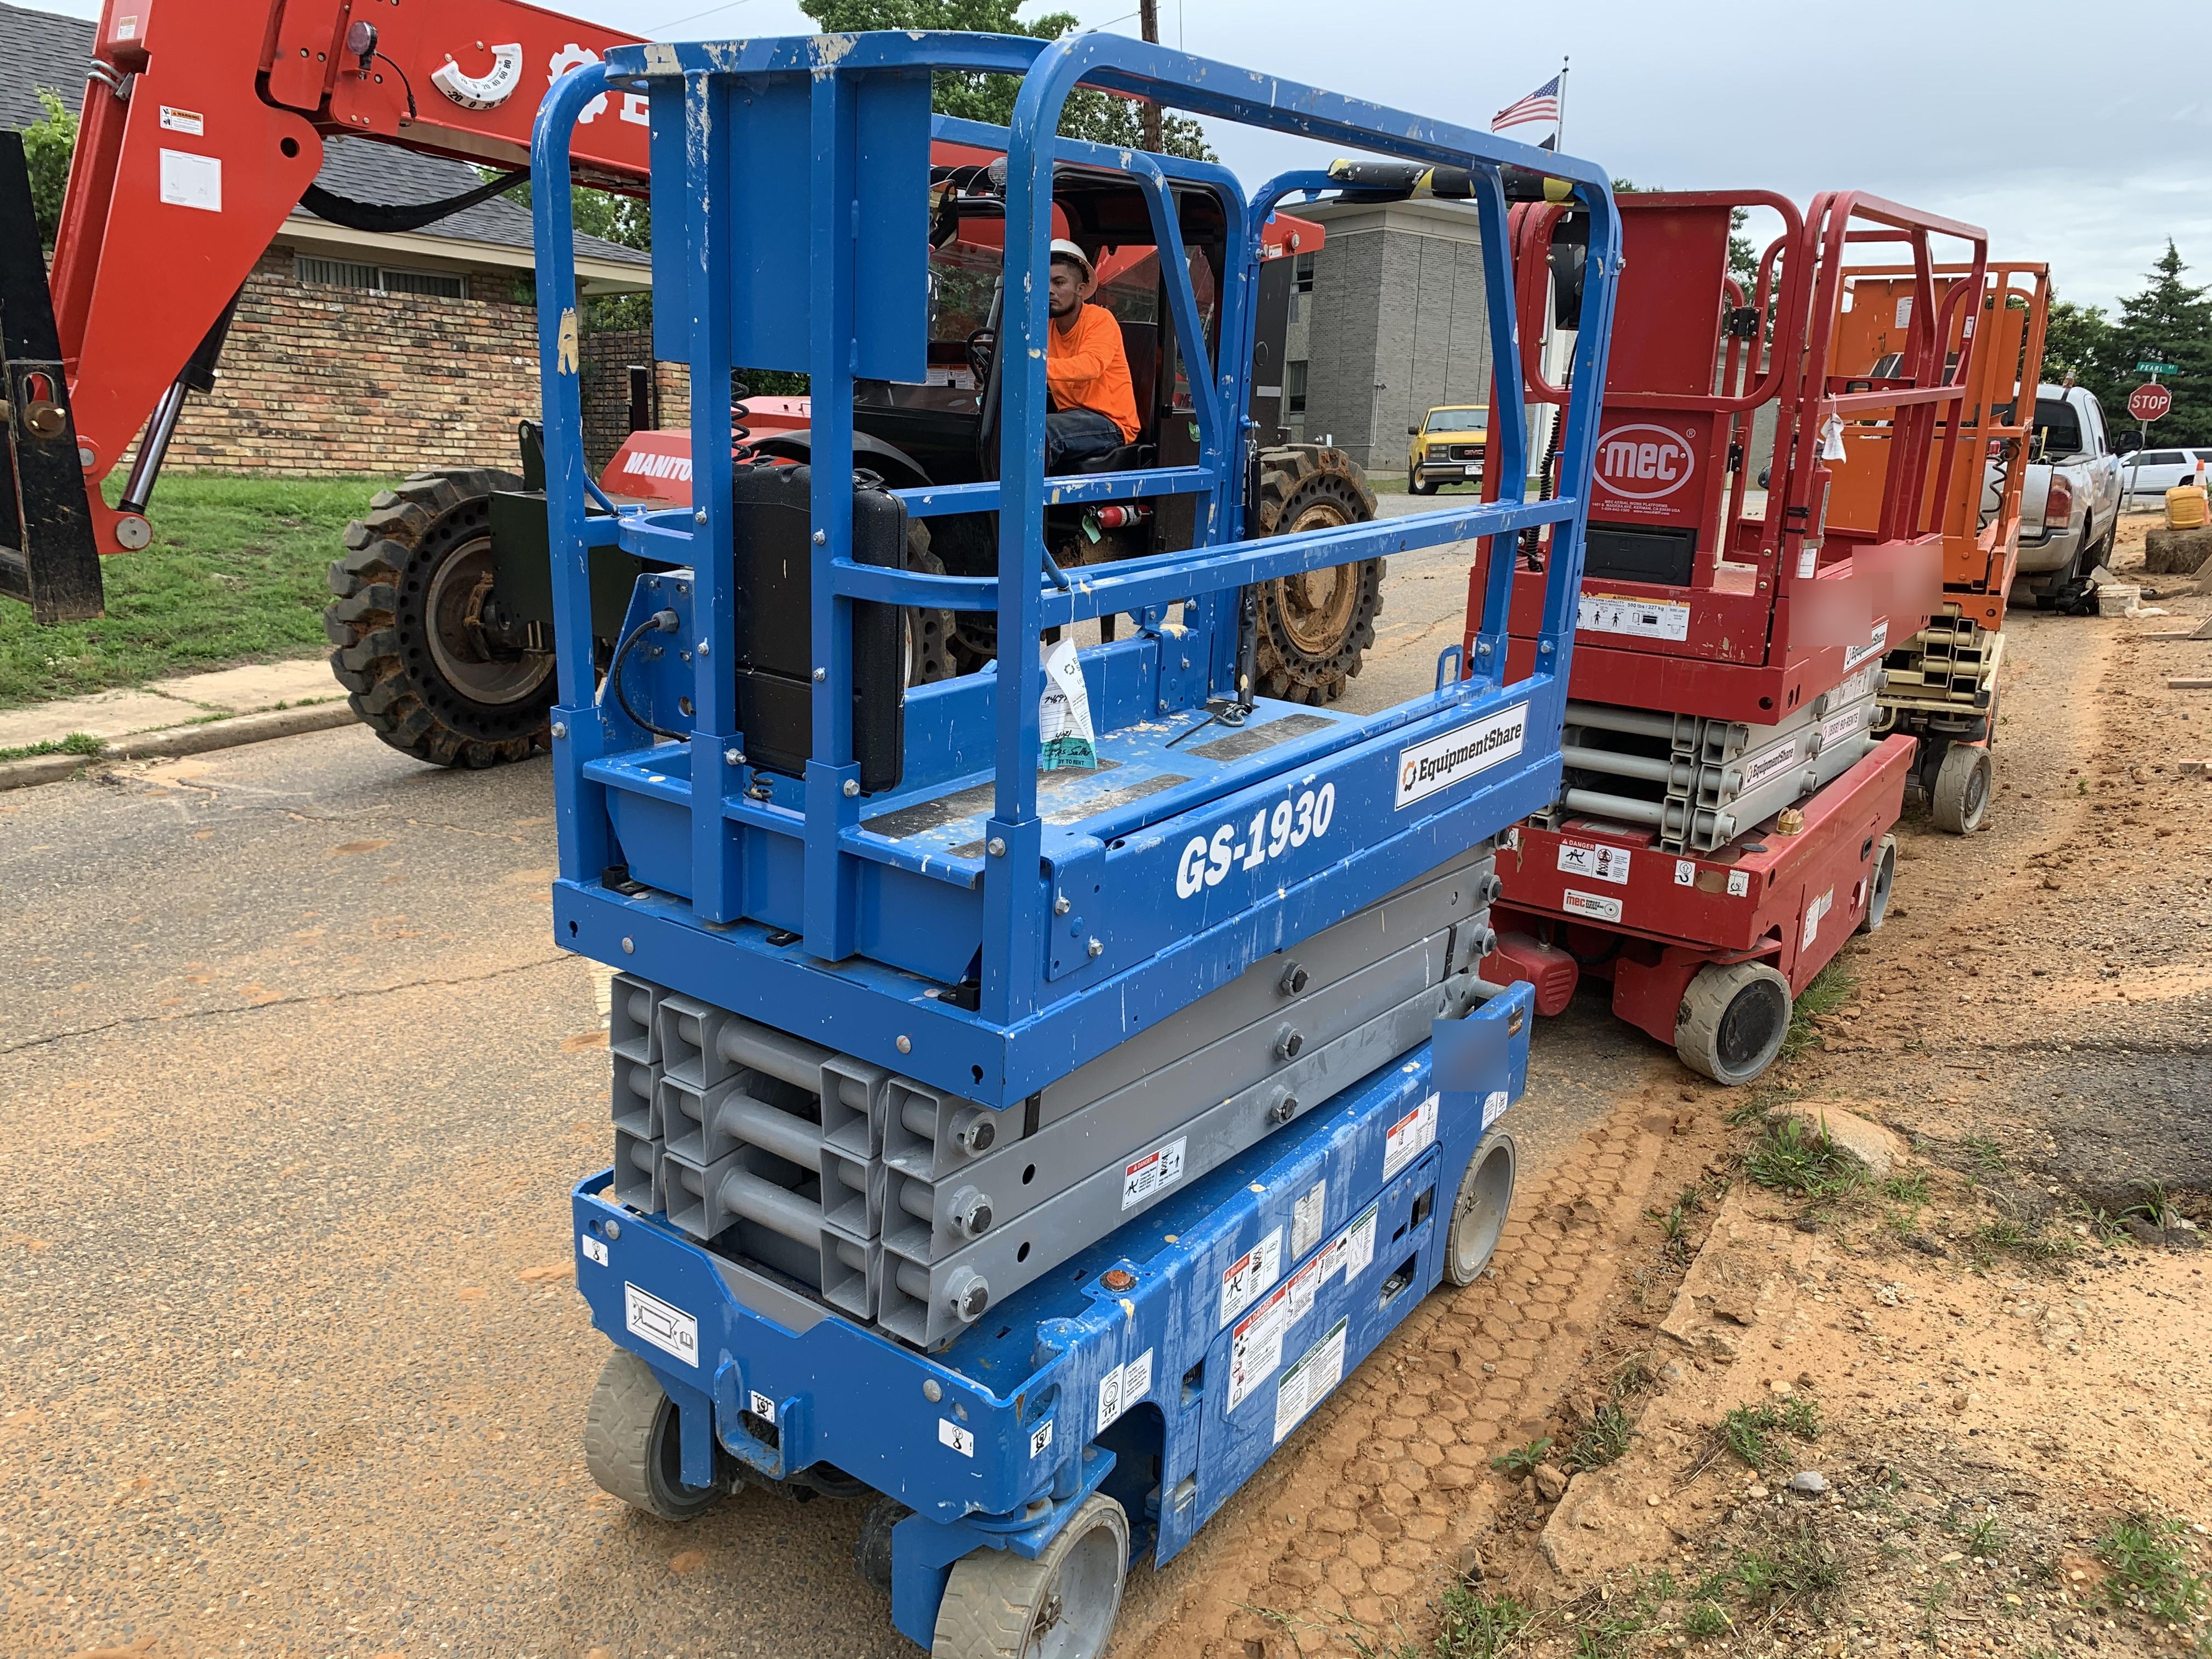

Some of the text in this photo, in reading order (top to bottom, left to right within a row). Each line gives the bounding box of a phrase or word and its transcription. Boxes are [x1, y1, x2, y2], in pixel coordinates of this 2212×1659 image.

[504, 59, 511, 69] 80
[499, 71, 507, 80] 60
[447, 90, 464, 103] -20
[177, 111, 200, 120] WARNING
[2131, 394, 2168, 410] STOP
[623, 452, 693, 482] MANITO
[1419, 723, 1521, 781] EquipmentShare
[1752, 747, 1794, 778] EquipmentShare
[1176, 782, 1335, 899] GS-1930
[1569, 840, 1595, 850] DANGER
[1137, 1156, 1153, 1169] DANGER
[1352, 1207, 1376, 1232] INSTRUCTIONS
[1230, 1258, 1248, 1277] DANGER
[1251, 1297, 1273, 1321] DANGER
[1298, 1334, 1330, 1369] INSTRUCTIONS
